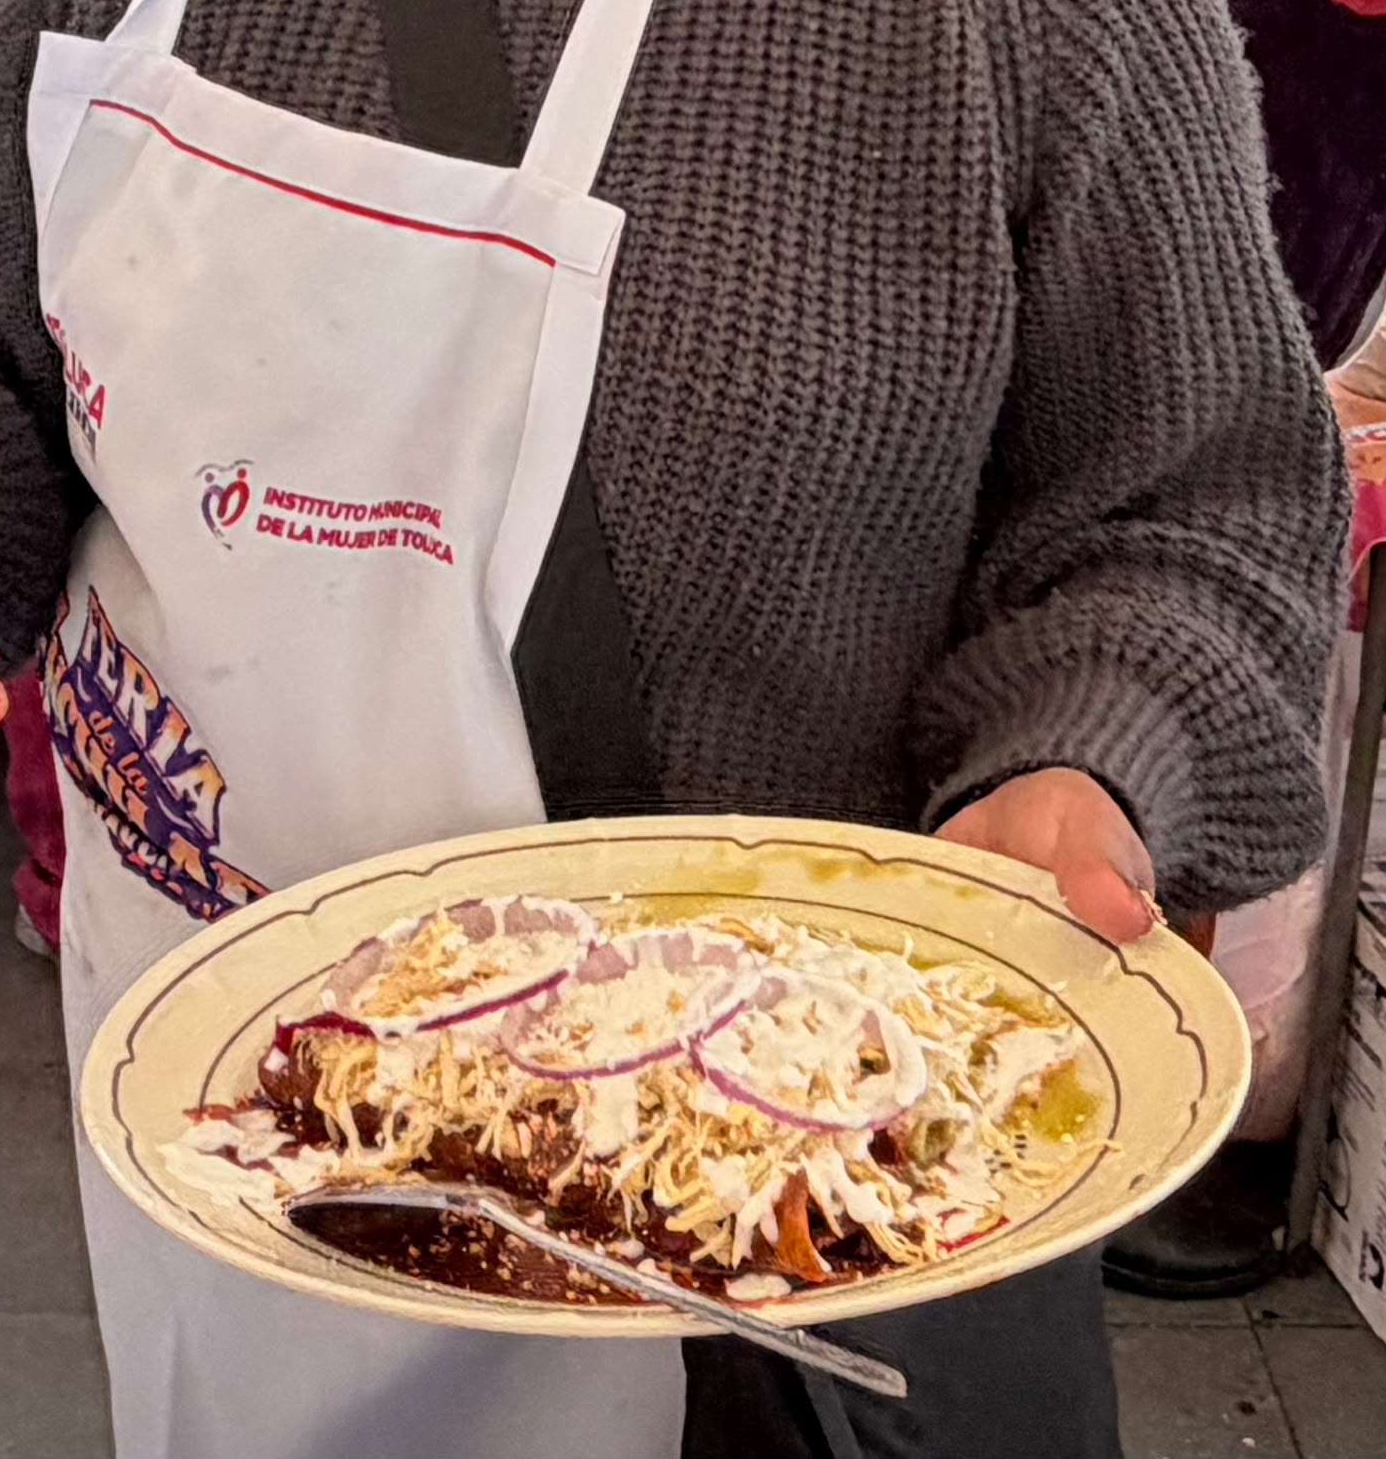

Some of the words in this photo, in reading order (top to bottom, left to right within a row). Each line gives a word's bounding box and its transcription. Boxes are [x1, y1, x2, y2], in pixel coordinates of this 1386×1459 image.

[263, 486, 367, 522] INSTITUTO
[368, 500, 442, 529] MUNICIPAL
[256, 513, 285, 538] DE
[286, 521, 313, 544] LA
[316, 527, 376, 550] MUJER
[377, 528, 399, 547] DE
[401, 527, 454, 566] TOLUCA
[88, 709, 117, 754] de
[116, 750, 150, 792] la
